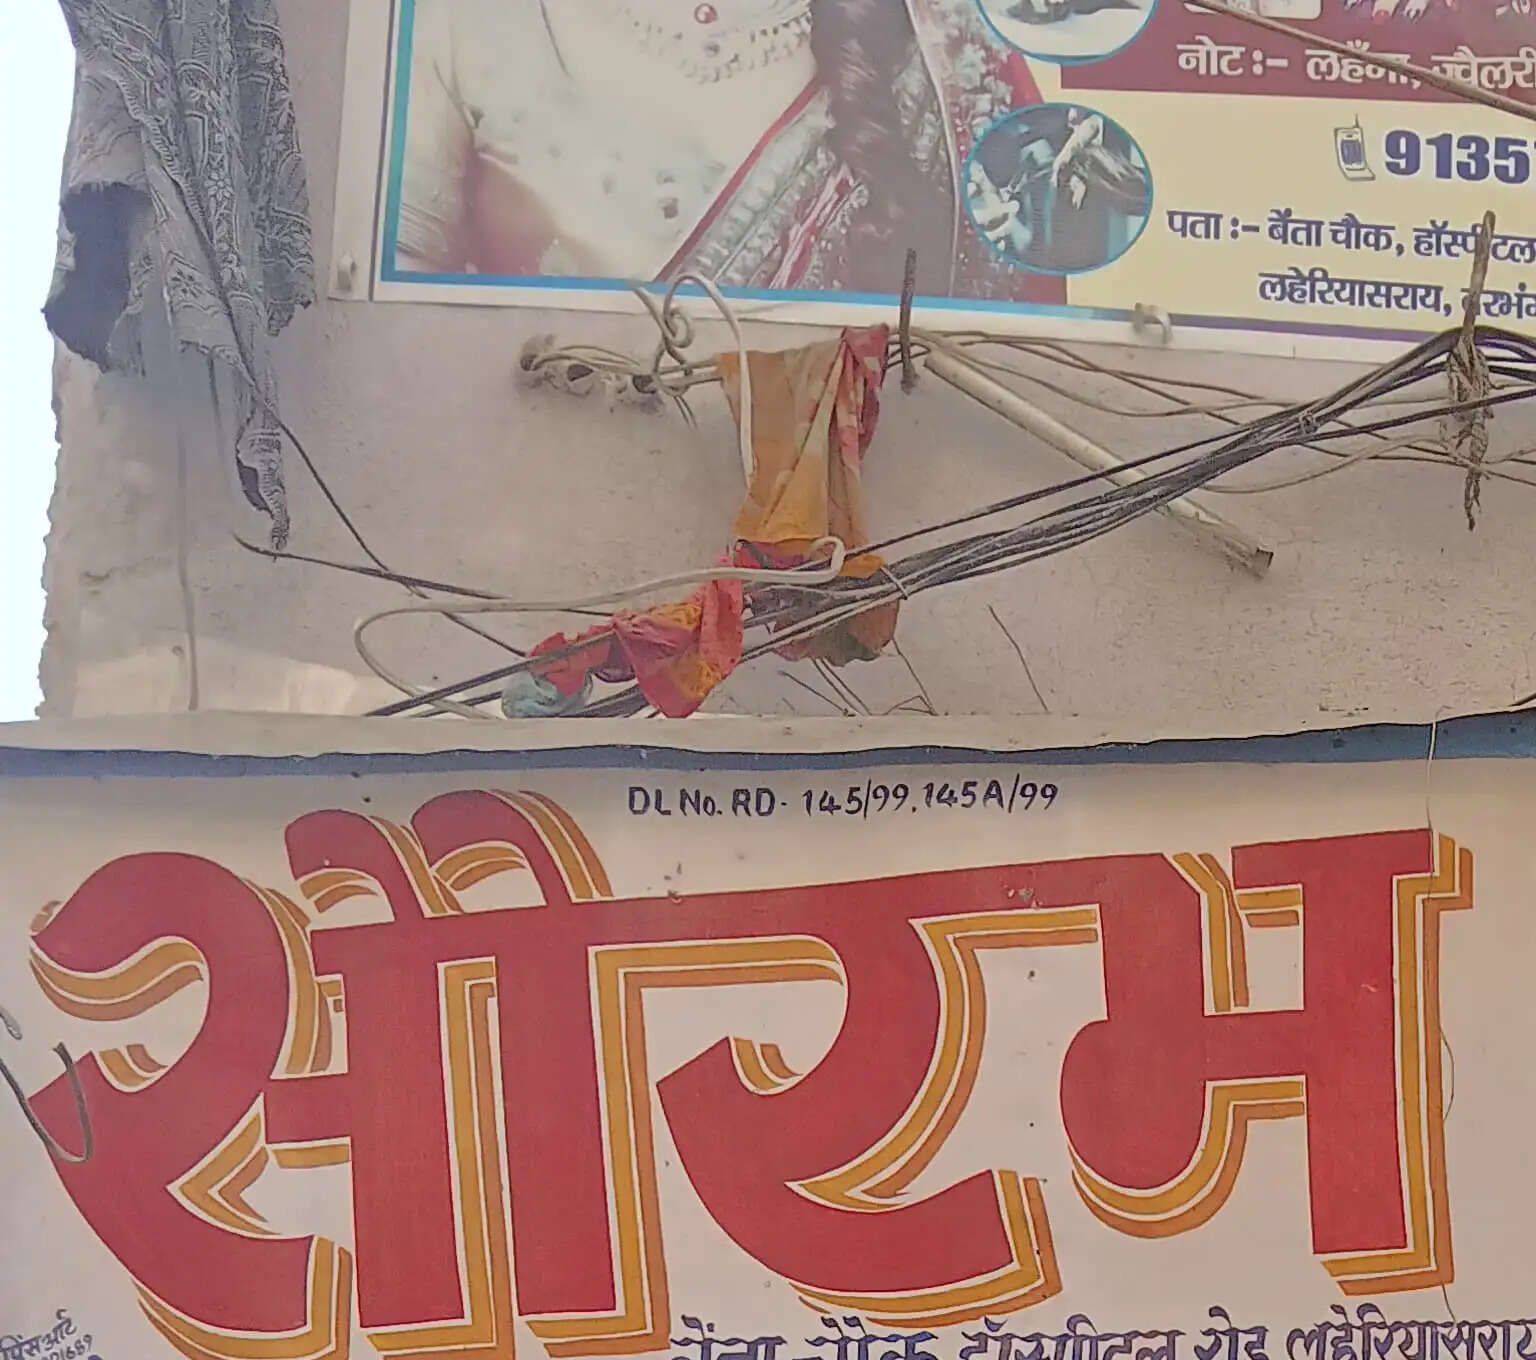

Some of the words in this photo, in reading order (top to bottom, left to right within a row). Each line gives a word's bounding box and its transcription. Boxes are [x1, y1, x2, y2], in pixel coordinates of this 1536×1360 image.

[1176, 35, 1246, 77] नोट
[1166, 209, 1224, 241] पता
[1329, 212, 1405, 257] चौक,
[1258, 266, 1453, 317] लहेरियासराय,
